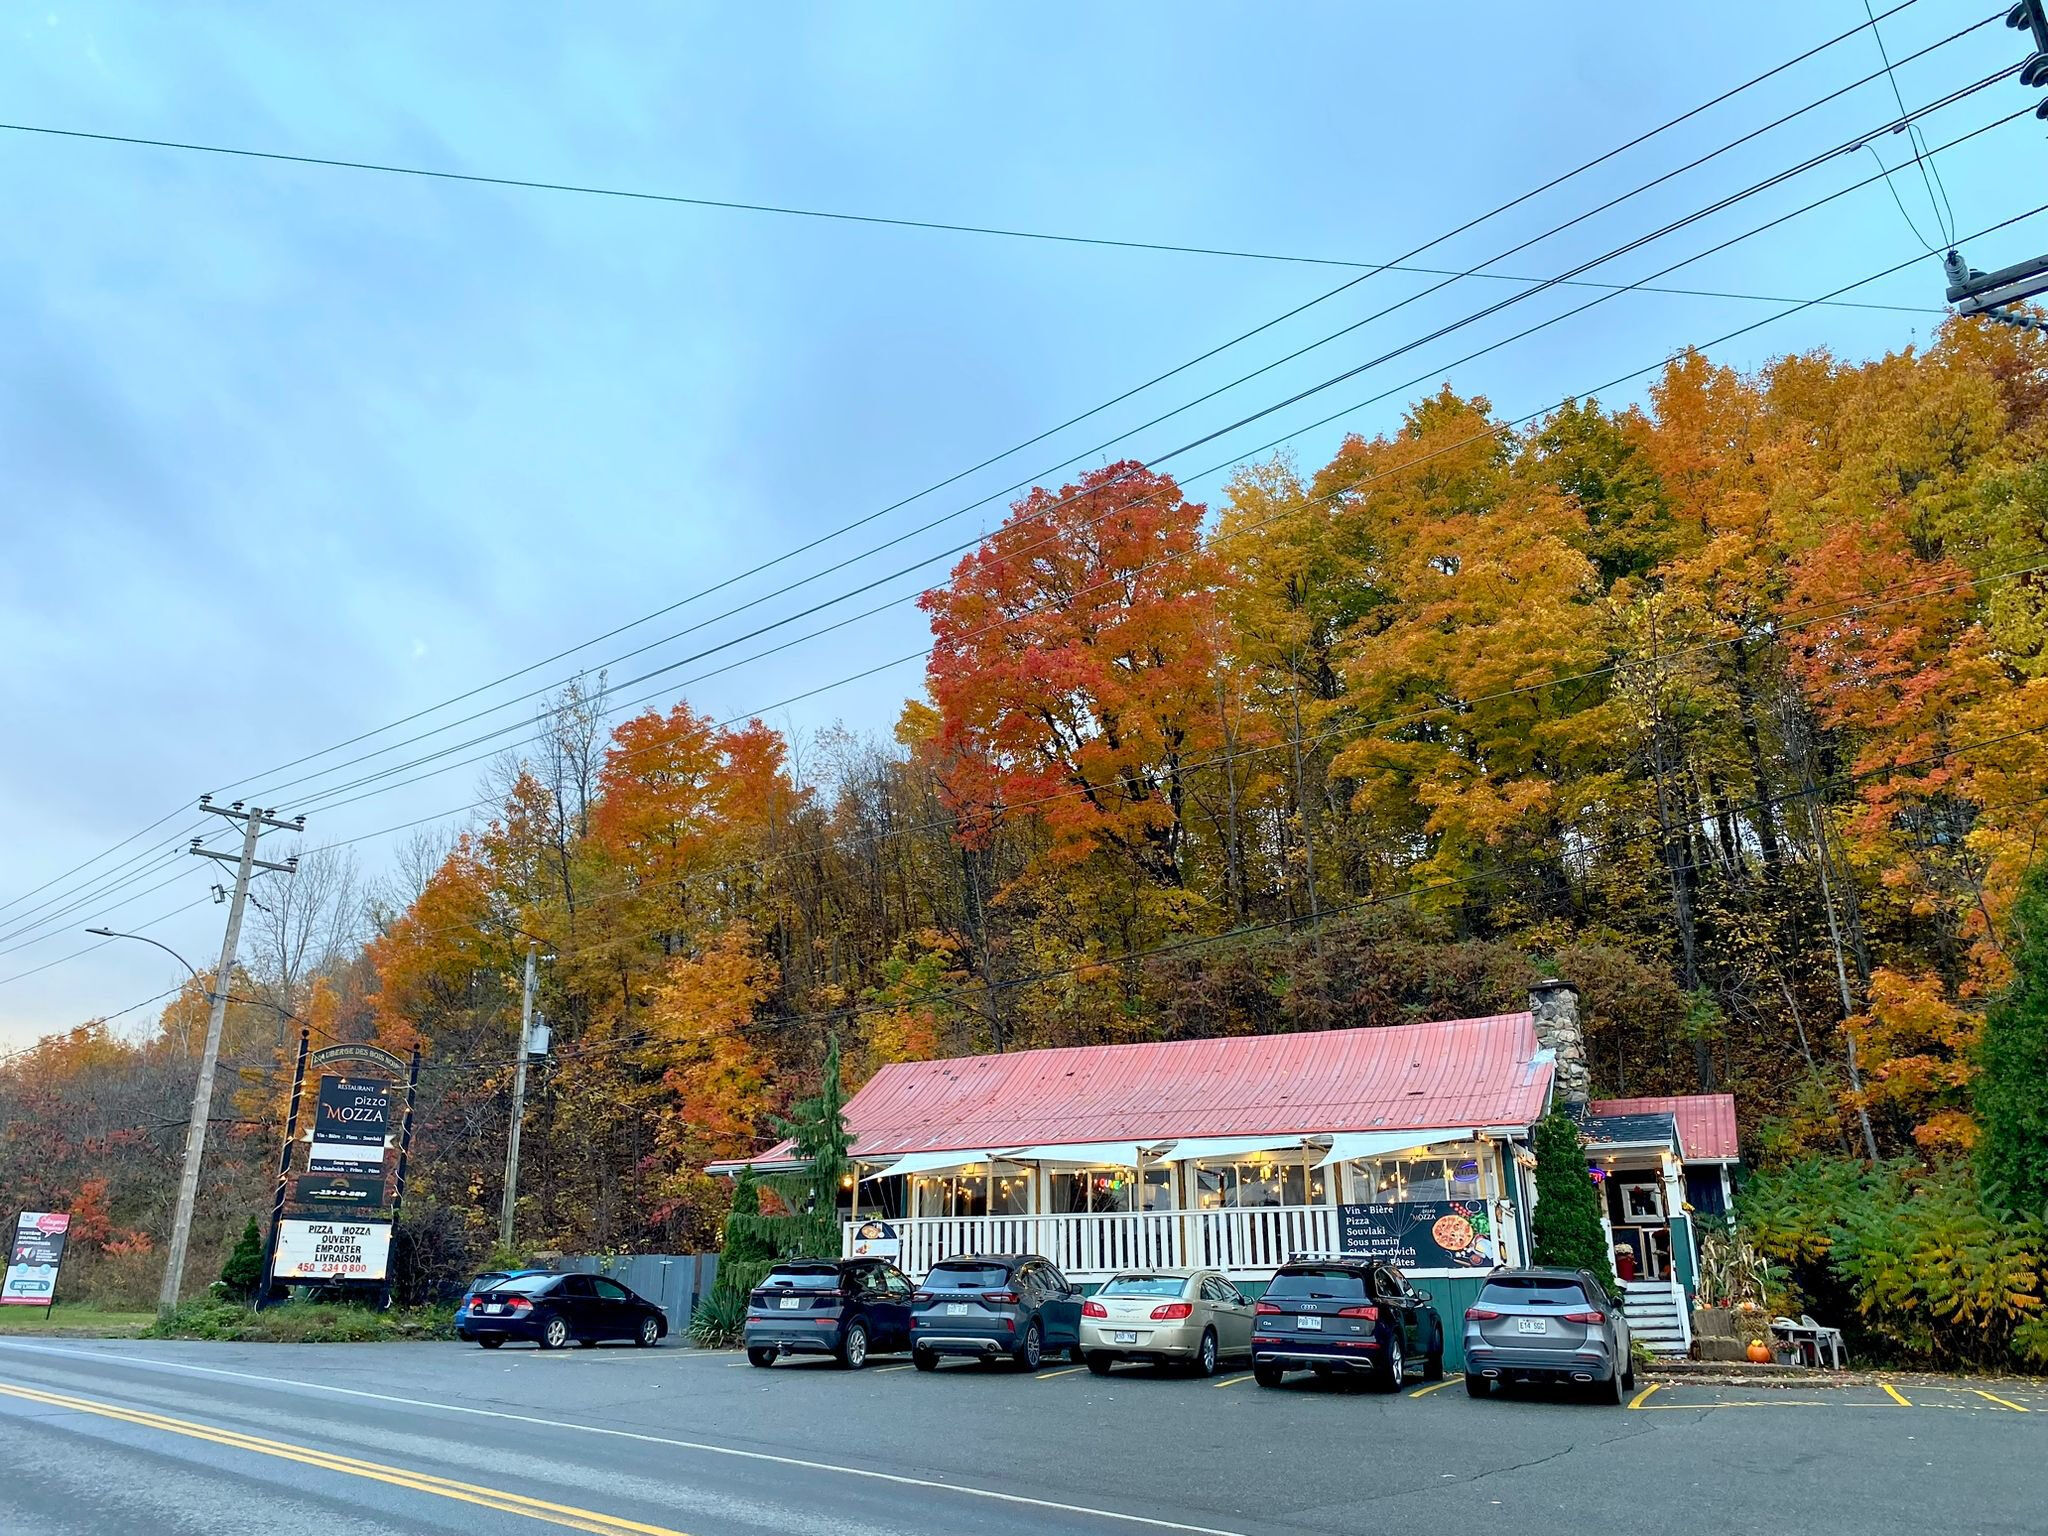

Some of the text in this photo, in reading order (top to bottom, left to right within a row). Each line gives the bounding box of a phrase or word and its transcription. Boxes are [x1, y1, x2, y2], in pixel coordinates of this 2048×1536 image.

[355, 1048, 369, 1057] DES
[369, 1050, 385, 1062] BOIS
[338, 1084, 375, 1093] RESTAURANT
[354, 1096, 387, 1107] pizza
[321, 1103, 385, 1123] MOZZA
[1344, 1206, 1361, 1215] Vin
[1369, 1205, 1394, 1215] Bière
[1346, 1217, 1370, 1226] Pizza
[308, 1225, 371, 1236] PIZZA MOZZA
[1346, 1226, 1386, 1236] Souvlaki
[321, 1235, 356, 1244] OUVERT
[1347, 1236, 1399, 1247] Sous marin
[315, 1244, 362, 1254] EMPORTER
[1371, 1247, 1417, 1257] Sandwich
[315, 1254, 361, 1263] LIVRAISON
[1390, 1258, 1416, 1267] Pâtes
[297, 1262, 315, 1272] 450
[321, 1263, 339, 1273] 234
[1520, 1322, 1531, 1330] E14
